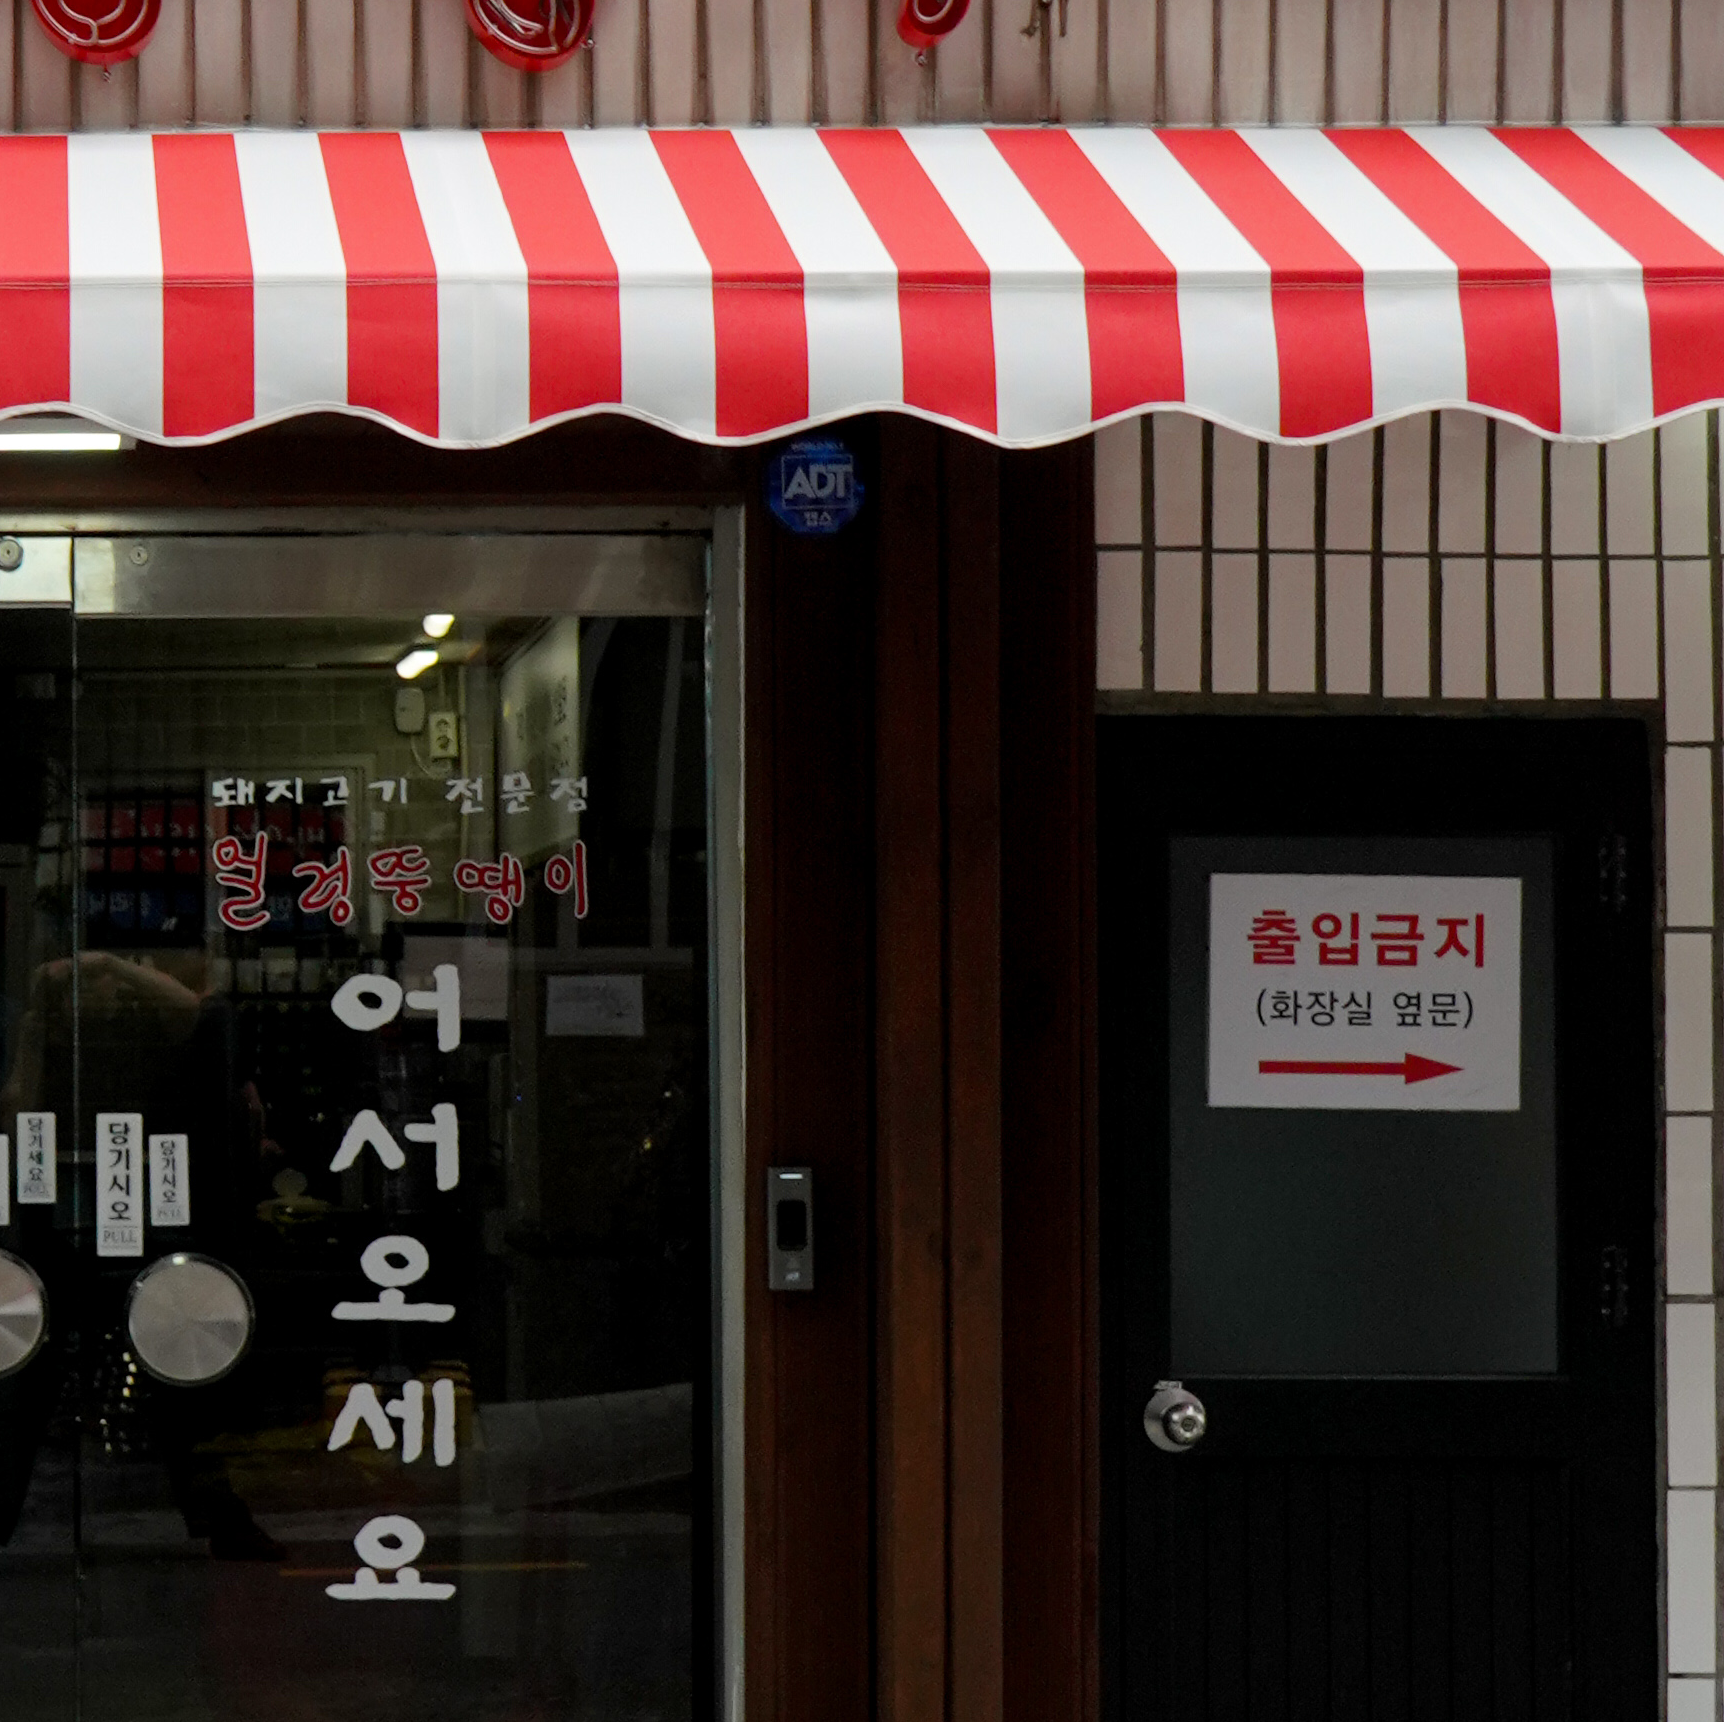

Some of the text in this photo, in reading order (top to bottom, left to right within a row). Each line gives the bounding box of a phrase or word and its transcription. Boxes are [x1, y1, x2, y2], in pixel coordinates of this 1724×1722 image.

[784, 463, 853, 499] ADT
[212, 772, 589, 814] 돼지고기 전문점
[1247, 909, 1485, 968] 출입금지
[1256, 988, 1474, 1028] (화장실 옆문)
[108, 1122, 131, 1220] 당기시오
[160, 1140, 177, 1204] 당기시오
[103, 1230, 138, 1244] PULL
